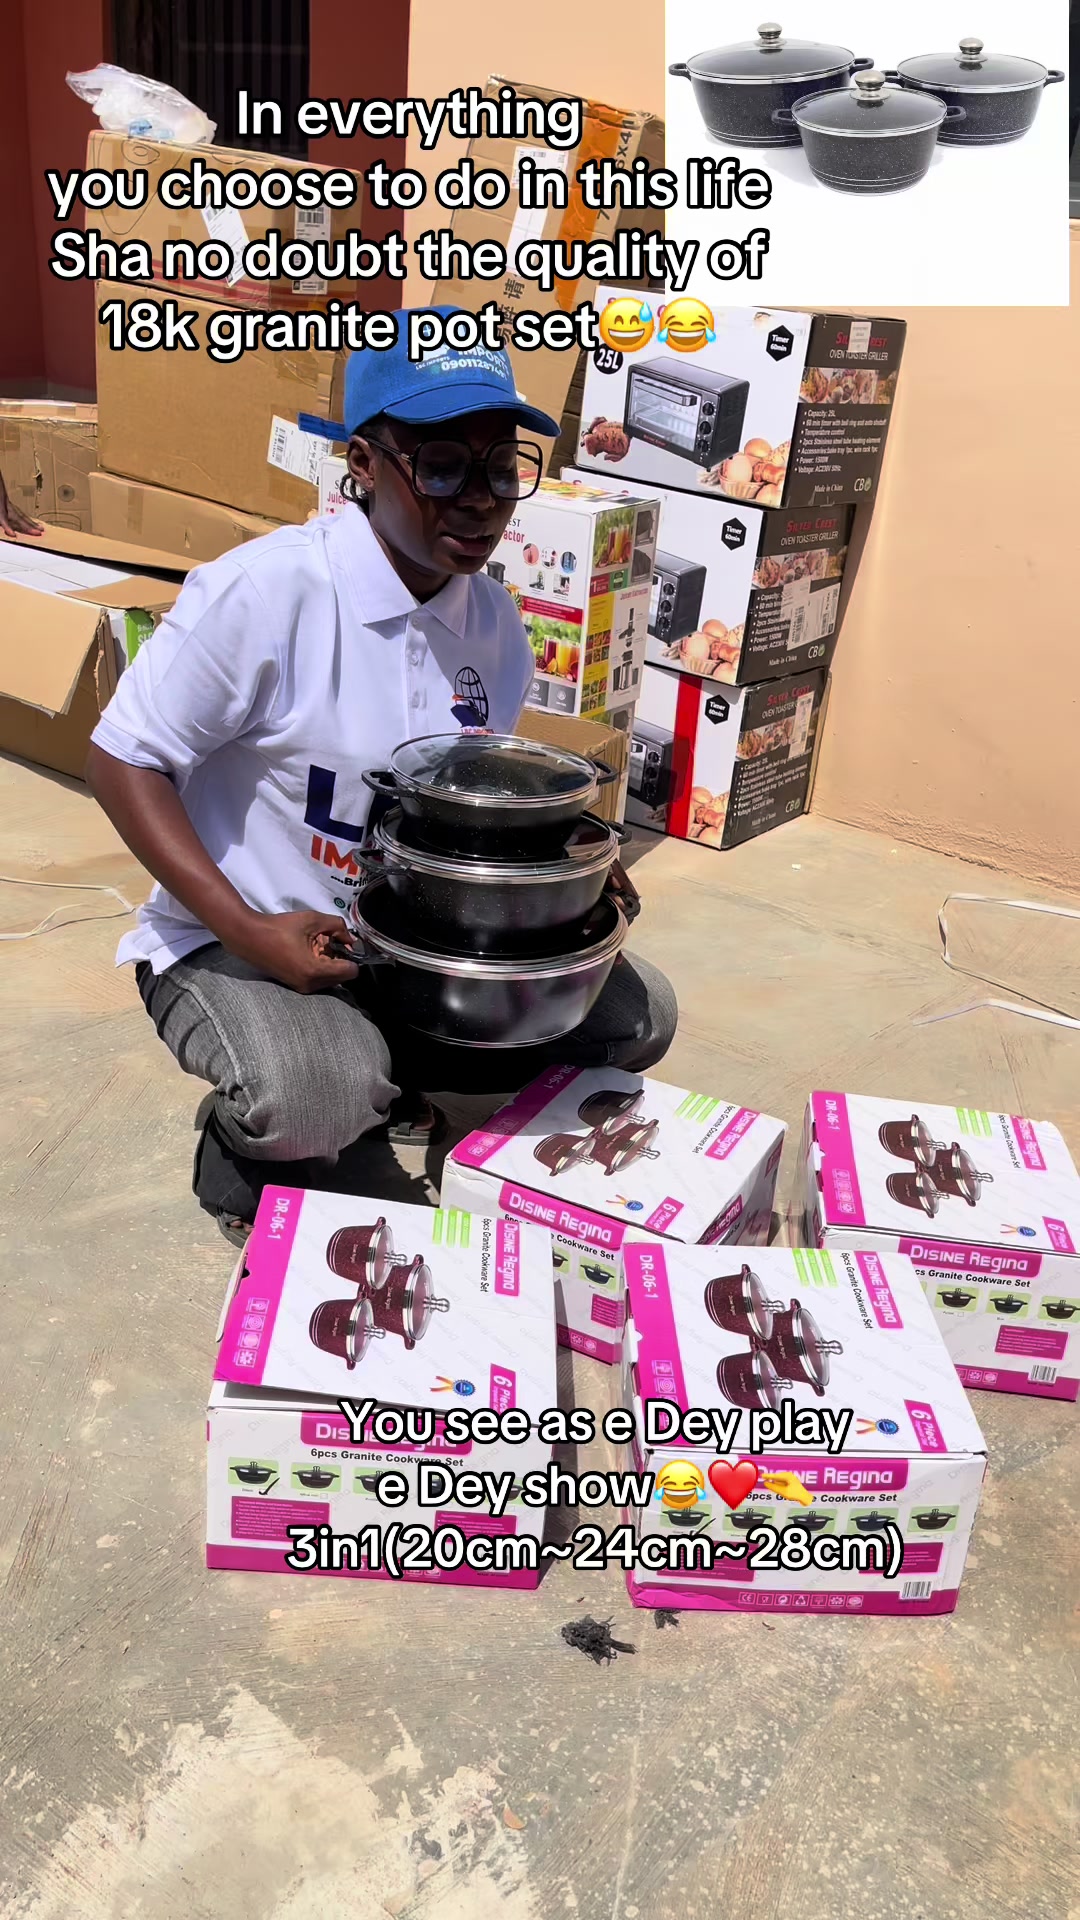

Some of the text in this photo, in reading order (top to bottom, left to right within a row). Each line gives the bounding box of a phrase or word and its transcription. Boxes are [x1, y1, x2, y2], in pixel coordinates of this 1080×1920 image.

[503, 278, 525, 299] 请
[772, 334, 789, 343] Timer
[770, 343, 787, 352] 60min
[830, 349, 888, 361] OVEN TOASTER GRILLER
[596, 349, 619, 369] 25L
[327, 491, 347, 505] Juice
[509, 517, 521, 527] EST
[726, 525, 742, 534] Timer
[503, 529, 525, 543] actor
[725, 533, 740, 542] 60min
[781, 531, 838, 546] OVEN TOASTER GRILLER
[710, 701, 726, 711] Timer
[762, 709, 775, 719] OVEN
[776, 702, 794, 714] TOASTER
[304, 764, 364, 842] L
[311, 834, 359, 876] IM
[543, 1064, 575, 1088] DR-06-1
[663, 1203, 677, 1213] 6
[267, 1197, 291, 1240] DR-06-1
[1047, 1223, 1065, 1232] 6
[482, 1231, 491, 1251] Granite
[556, 1234, 615, 1261] Cookware Set
[481, 1252, 490, 1281] Cookware
[640, 1254, 659, 1298] DR-06-1
[929, 1269, 963, 1281] Granite
[965, 1274, 1012, 1286] Cookware
[1014, 1280, 1031, 1288] Set
[480, 1282, 489, 1293] Set
[840, 1252, 874, 1329] 6pcs Granite Cookware Set
[493, 1375, 512, 1387] 6
[911, 1409, 932, 1420] 6
[922, 1421, 938, 1448] Piece
[310, 1448, 464, 1467] 6pcs Granite Cookware Set
[821, 1494, 875, 1503] Cookware
[879, 1494, 897, 1502] Set
